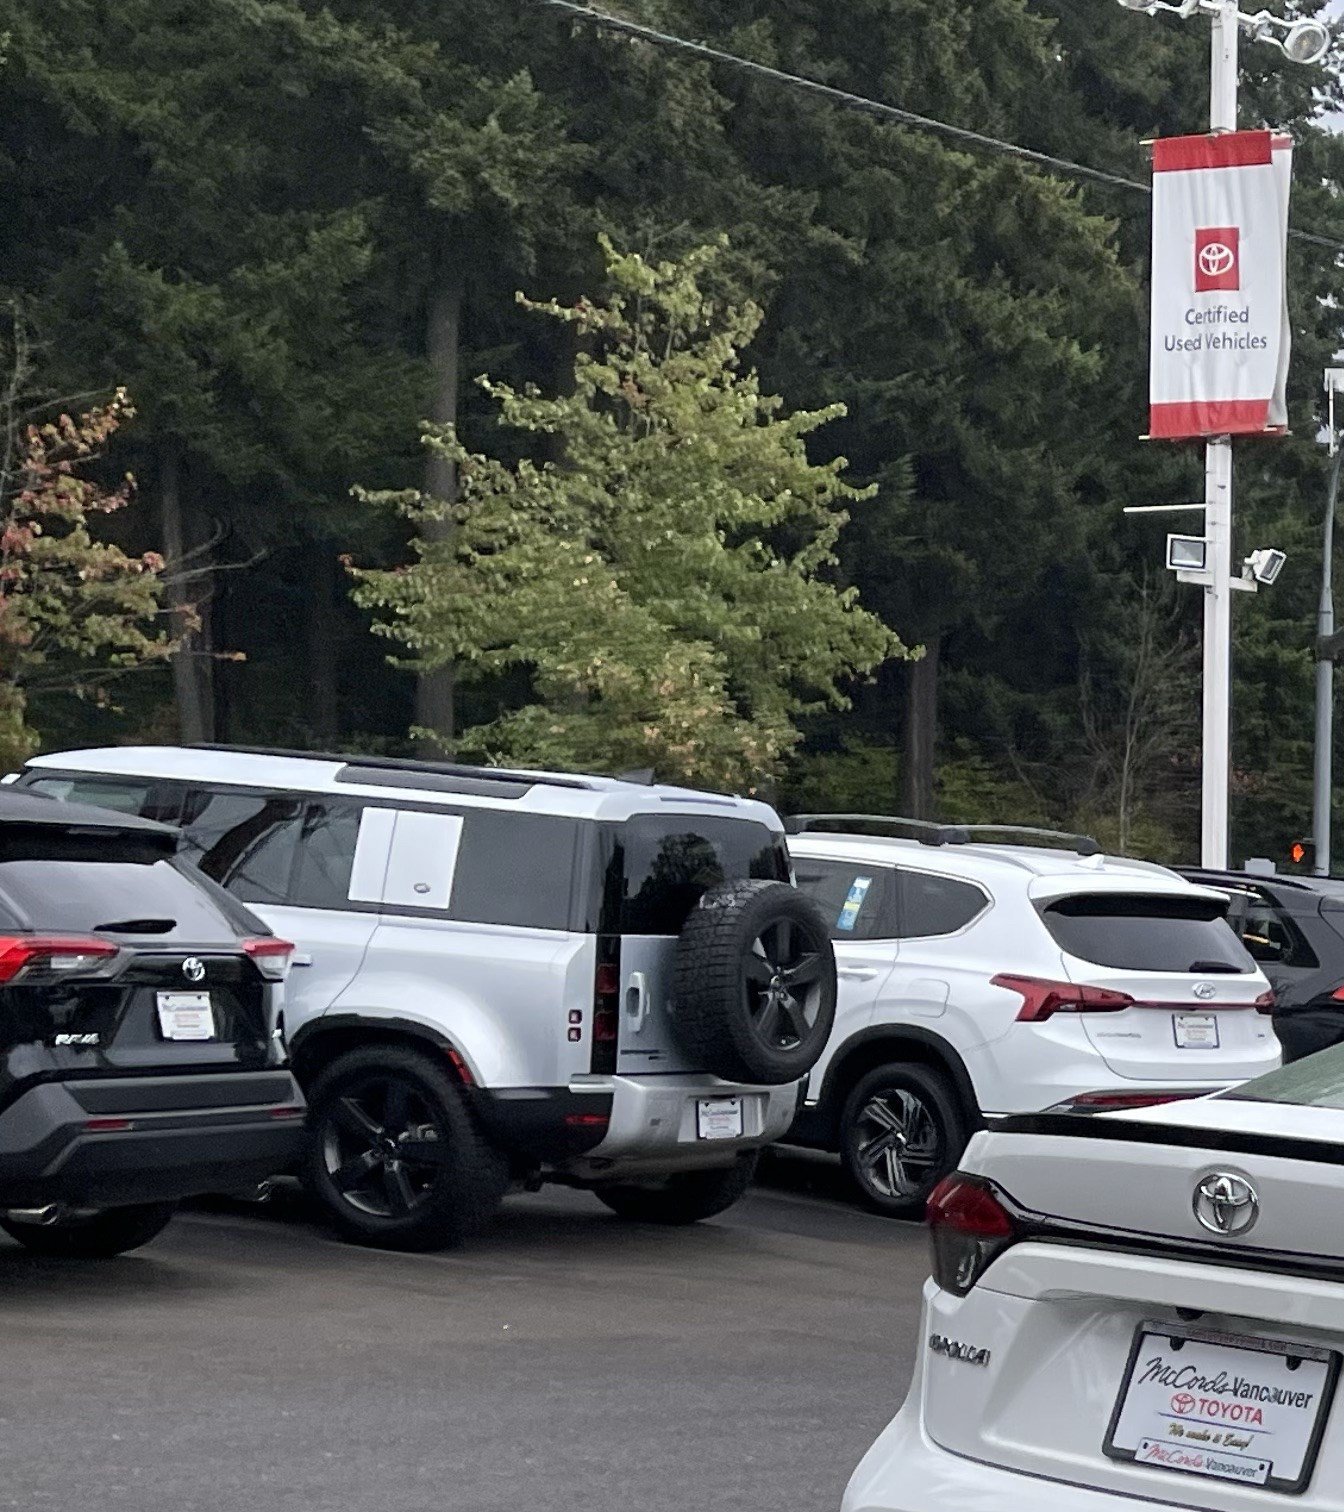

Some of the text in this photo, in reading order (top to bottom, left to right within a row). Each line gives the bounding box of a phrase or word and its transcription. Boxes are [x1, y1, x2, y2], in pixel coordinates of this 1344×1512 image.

[1185, 306, 1249, 325] Certified
[1165, 333, 1267, 351] Used Vehicles
[1198, 1398, 1263, 1425] TOYOTA
